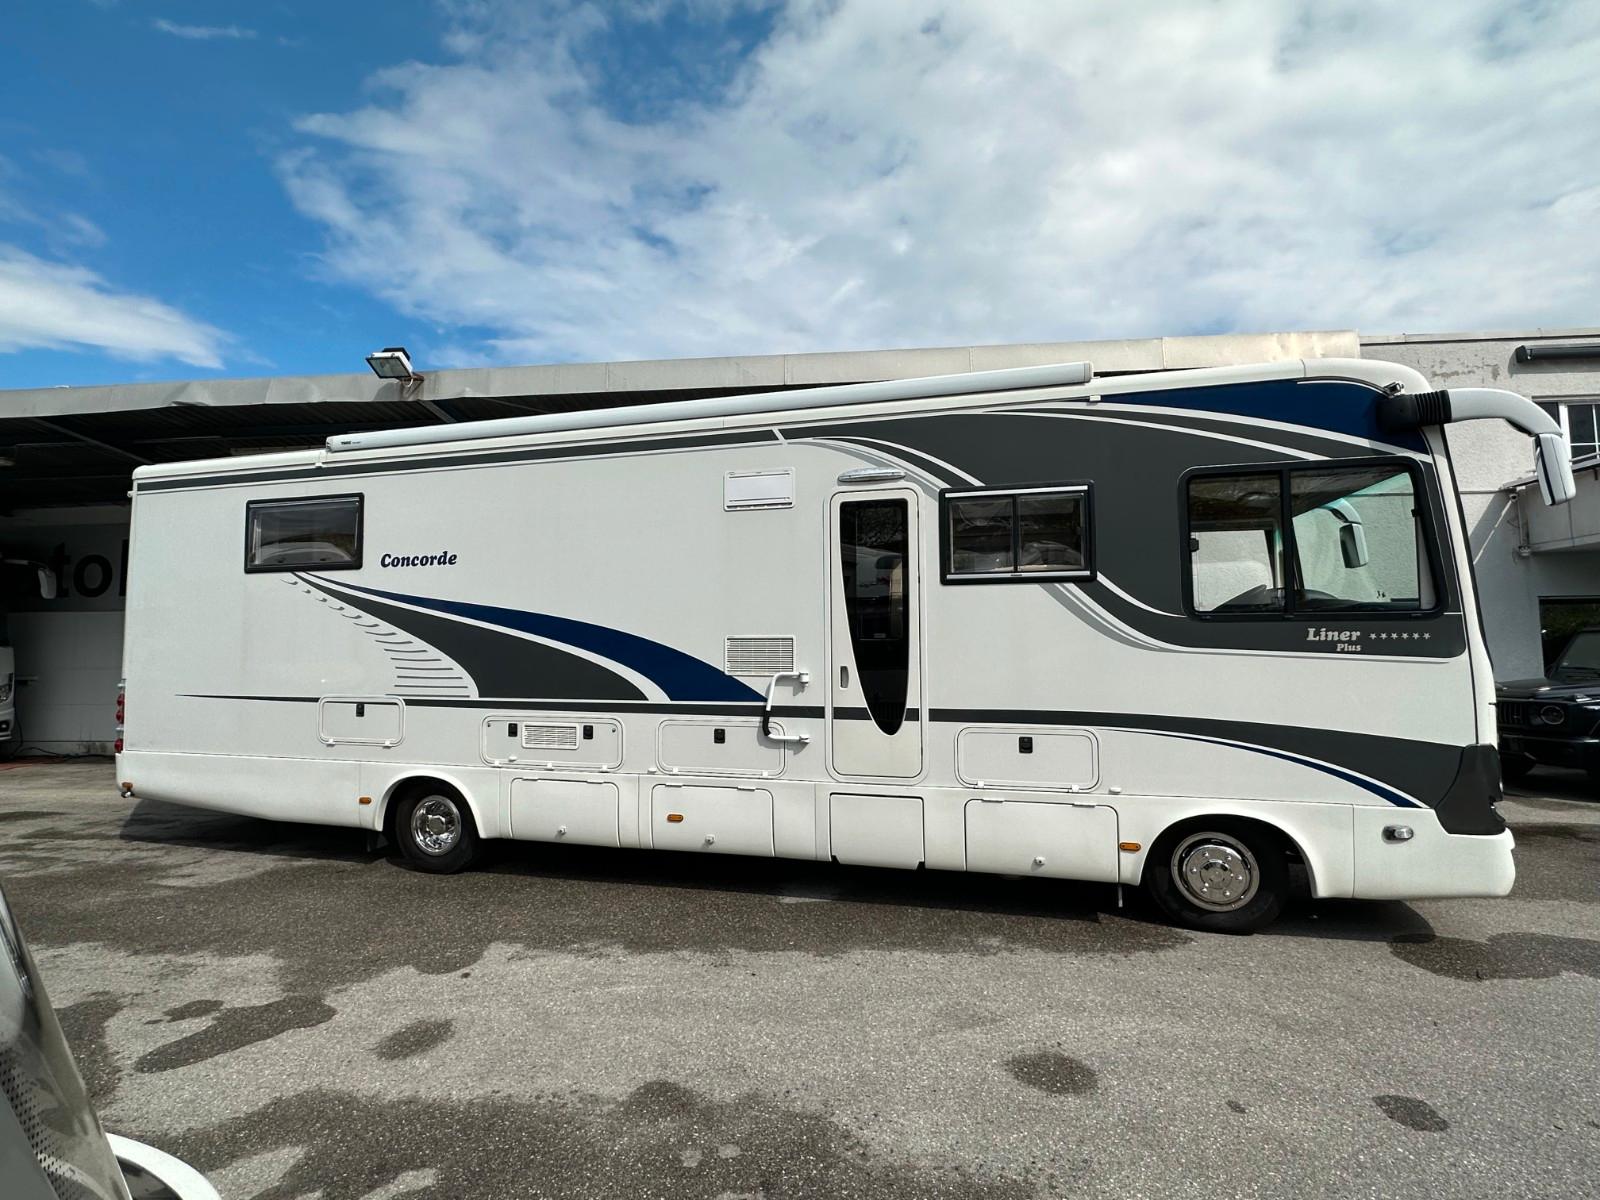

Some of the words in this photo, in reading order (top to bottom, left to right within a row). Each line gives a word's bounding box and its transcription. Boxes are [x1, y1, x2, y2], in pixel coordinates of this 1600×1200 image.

[380, 550, 458, 568] Concorde
[1306, 627, 1361, 641] Liner
[1336, 643, 1362, 652] Plus
